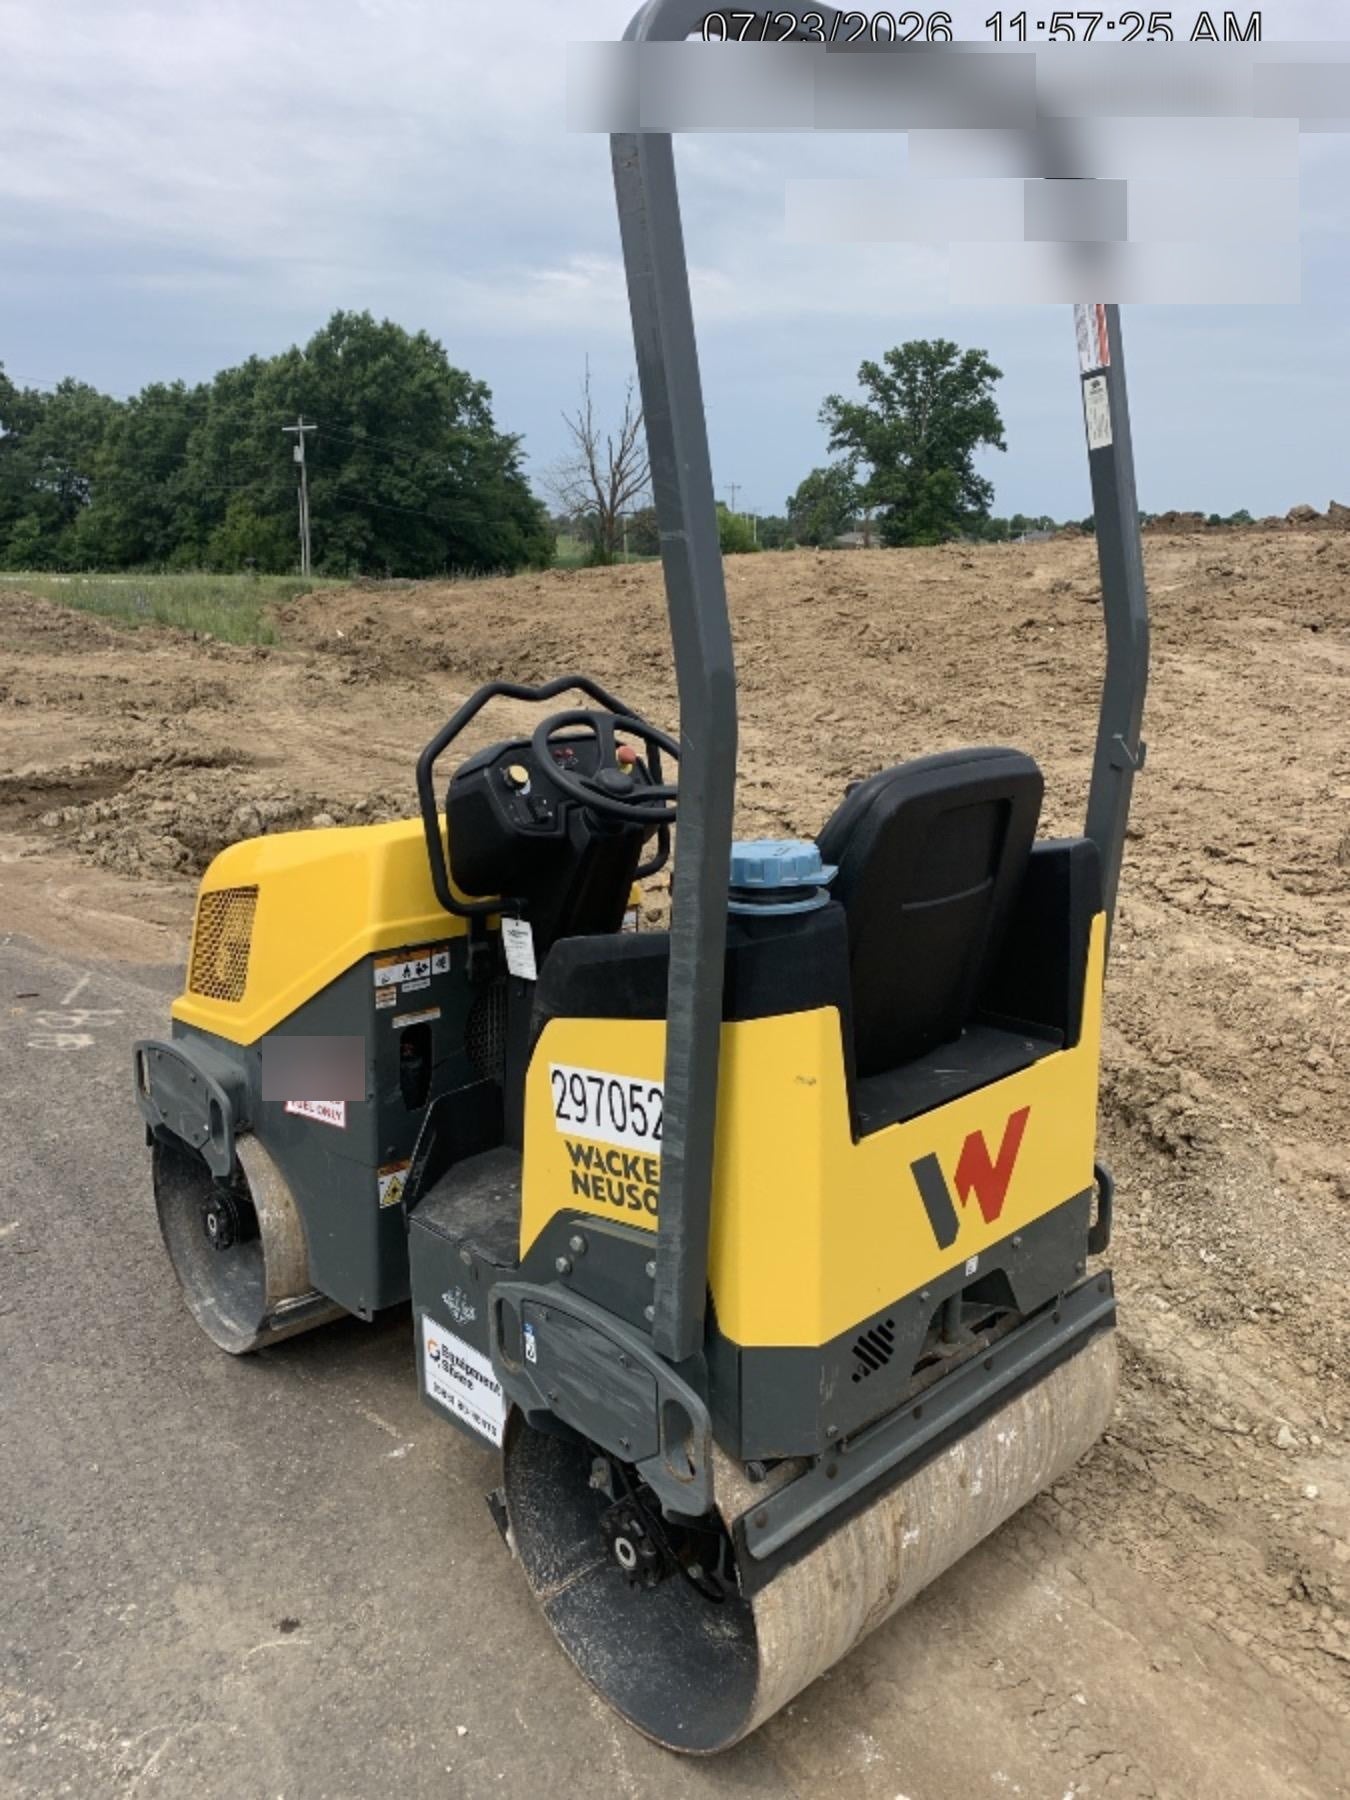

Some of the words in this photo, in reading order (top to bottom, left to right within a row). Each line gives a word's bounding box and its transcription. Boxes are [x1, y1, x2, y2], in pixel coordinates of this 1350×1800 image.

[552, 1069, 663, 1140] 297052
[565, 1139, 660, 1187] WACKE
[570, 1169, 659, 1217] NEUSO
